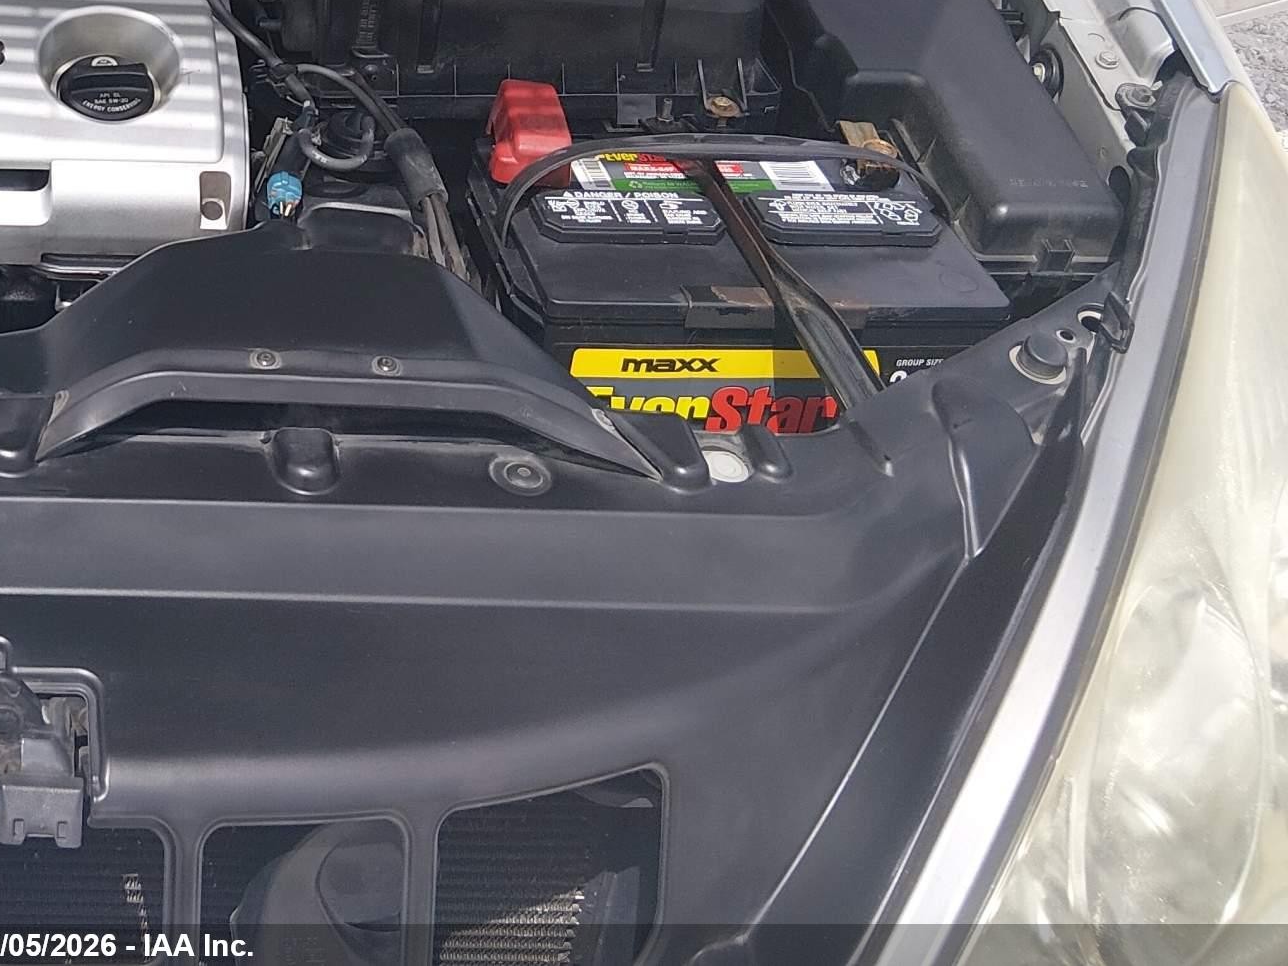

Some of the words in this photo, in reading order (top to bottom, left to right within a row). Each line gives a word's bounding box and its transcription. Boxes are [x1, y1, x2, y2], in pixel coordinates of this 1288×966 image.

[574, 192, 622, 200] DANGER
[634, 192, 679, 200] POISON
[620, 357, 722, 373] maxx
[895, 359, 924, 367] GROUP
